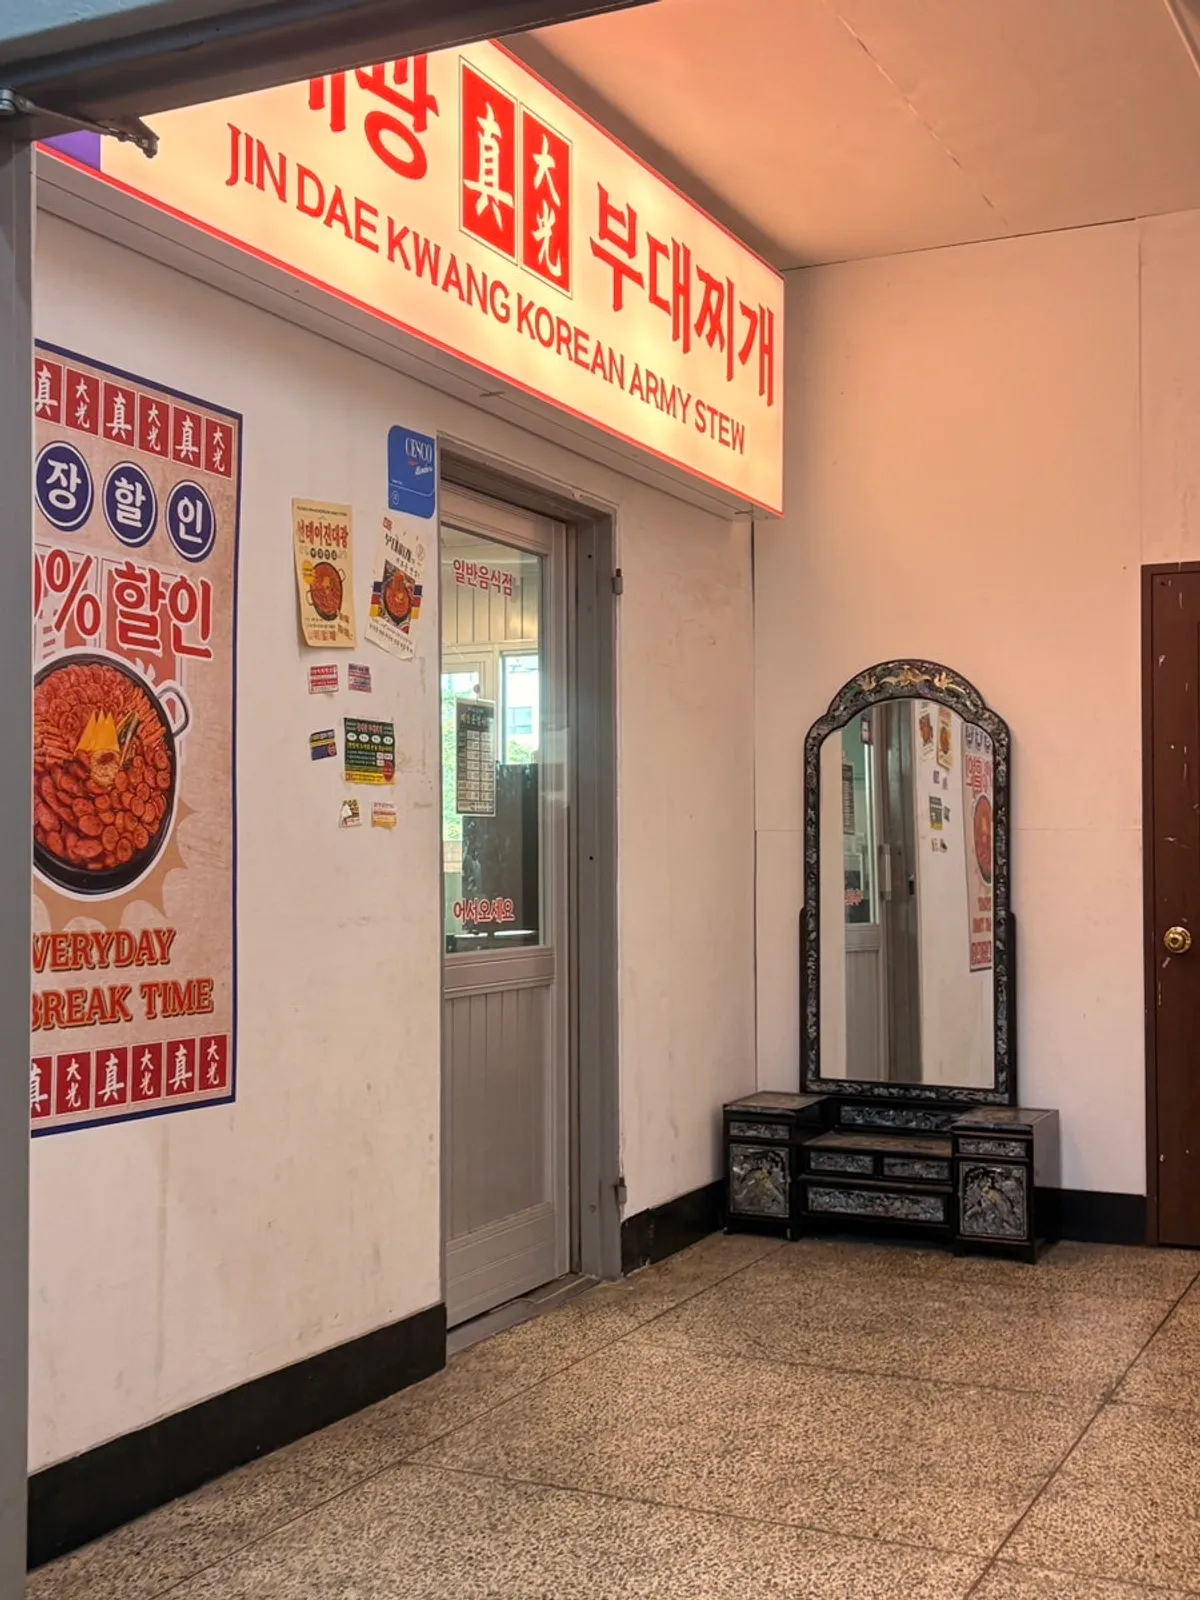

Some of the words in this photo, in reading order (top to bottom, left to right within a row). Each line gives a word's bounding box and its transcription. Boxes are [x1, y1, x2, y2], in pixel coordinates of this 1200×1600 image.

[308, 51, 440, 181] 광
[463, 101, 515, 231] 真
[225, 122, 287, 203] JIN
[296, 162, 380, 253] DAE
[386, 215, 511, 324] KWANG
[517, 292, 625, 390] KOREAN
[629, 362, 692, 424] ARMY
[694, 398, 746, 456] STEW
[589, 181, 775, 407] 부대찌개
[113, 560, 213, 659] 할인
[453, 559, 513, 597] 일반음식점
[453, 897, 516, 924] 어서오세요
[140, 978, 214, 1020] TIME
